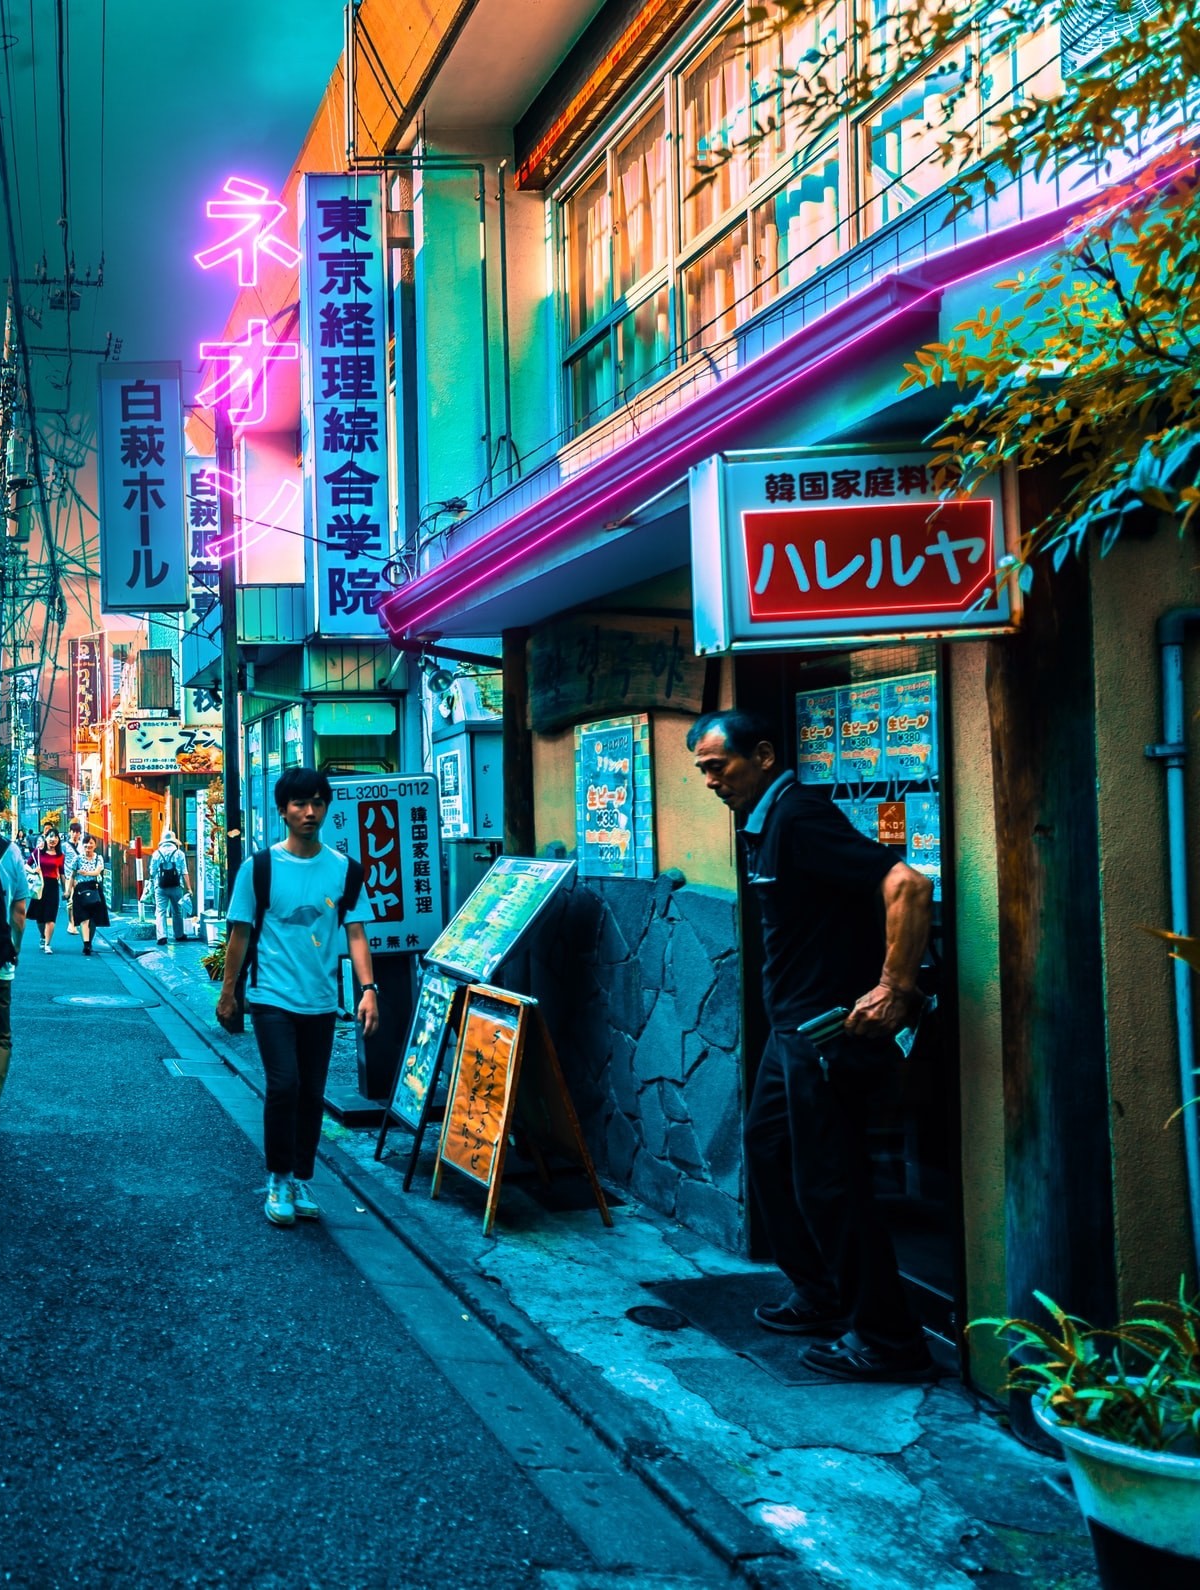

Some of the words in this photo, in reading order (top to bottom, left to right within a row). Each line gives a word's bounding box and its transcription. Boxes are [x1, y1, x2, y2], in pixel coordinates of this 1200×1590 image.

[194, 177, 301, 562] ネオン
[316, 196, 384, 617] 東京経理綜合学院
[120, 379, 170, 589] 白萩ホール
[753, 530, 987, 595] ハレルヤ
[136, 728, 216, 753] シーズン
[364, 804, 400, 918] ハレルヤ
[410, 806, 434, 915] 韓国家庭料理
